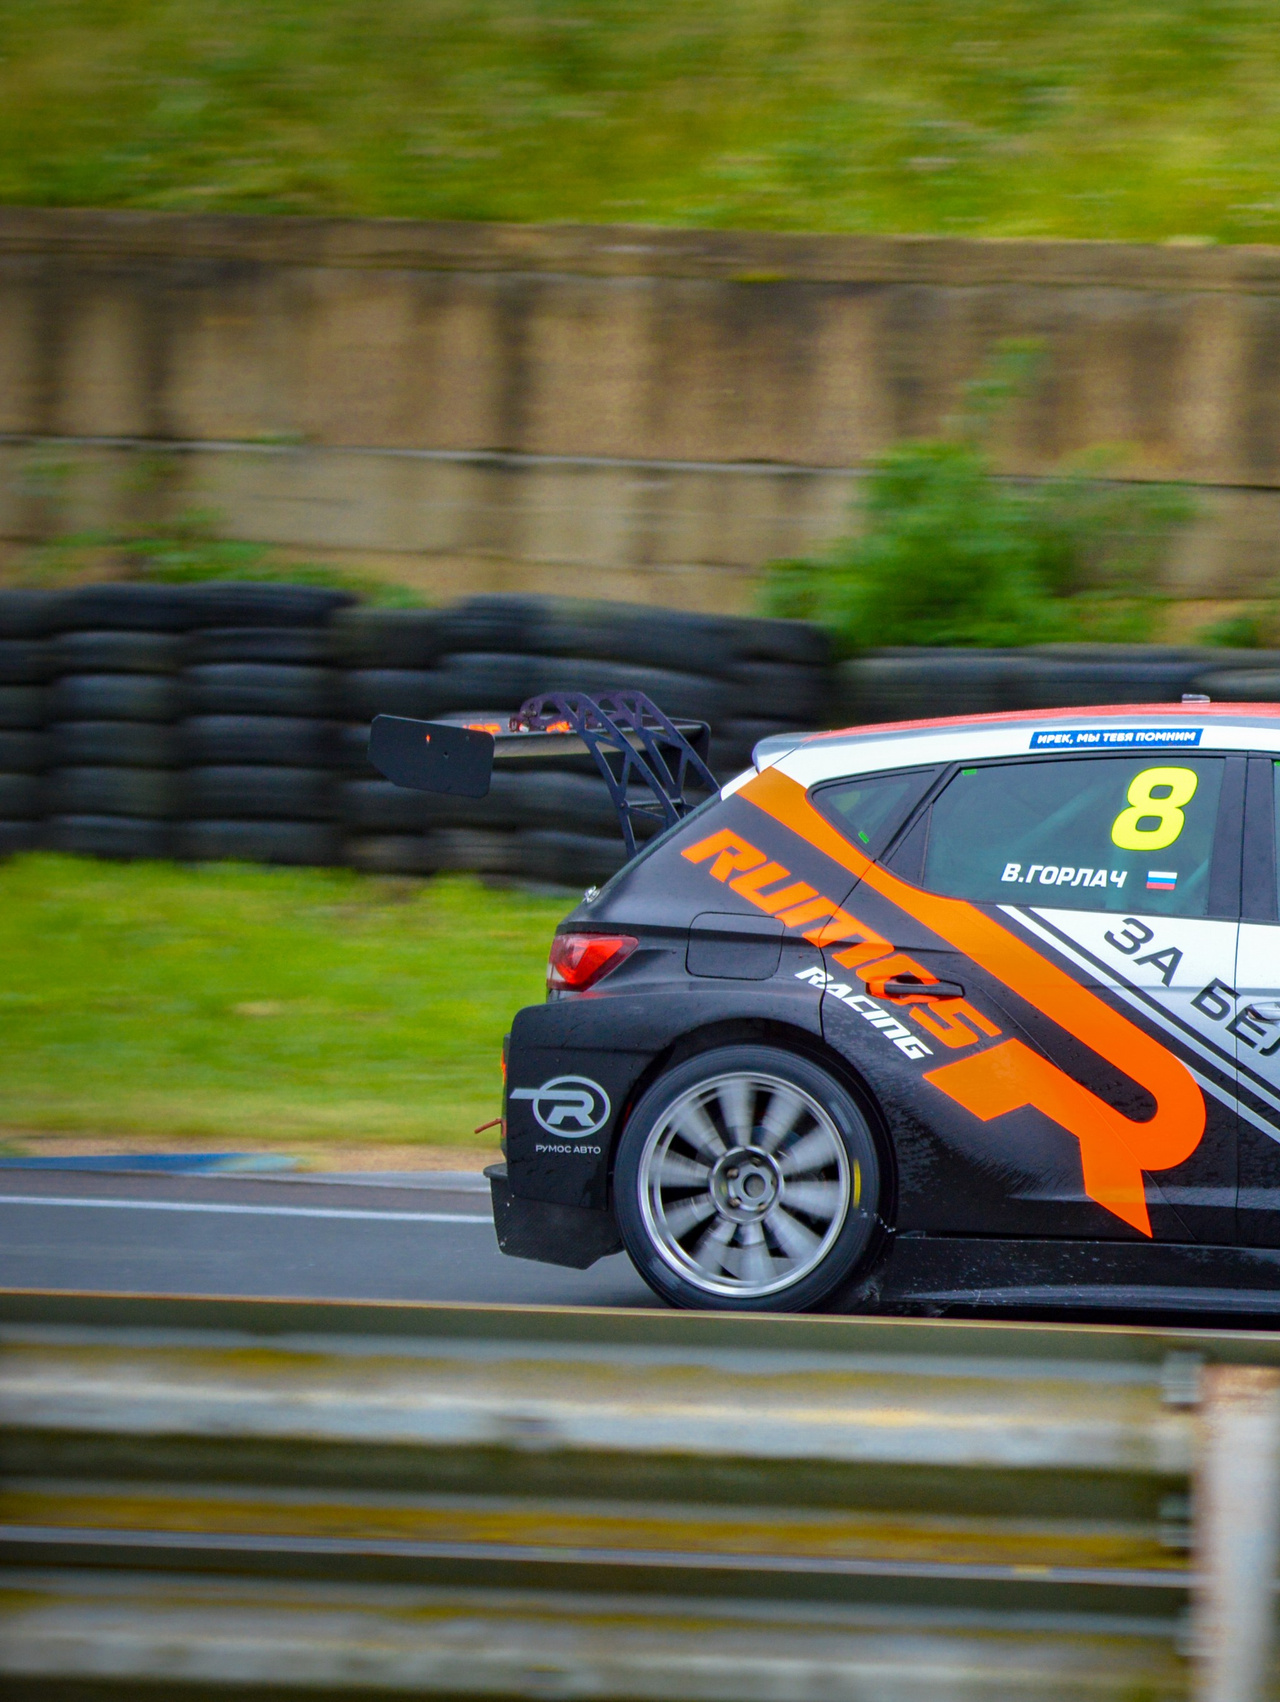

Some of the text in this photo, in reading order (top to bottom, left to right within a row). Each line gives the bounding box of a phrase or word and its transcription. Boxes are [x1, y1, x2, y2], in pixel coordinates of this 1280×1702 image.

[1036, 732, 1197, 745] ИРЕК, МЫ ТЕБЯ ПОМНИМ
[1111, 766, 1198, 851] 8
[1001, 863, 1128, 889] В.ГОРЛАЧ
[1103, 917, 1183, 988] ЗА
[794, 966, 934, 1060] RACING
[535, 1144, 601, 1155] РУМОС АВТО
